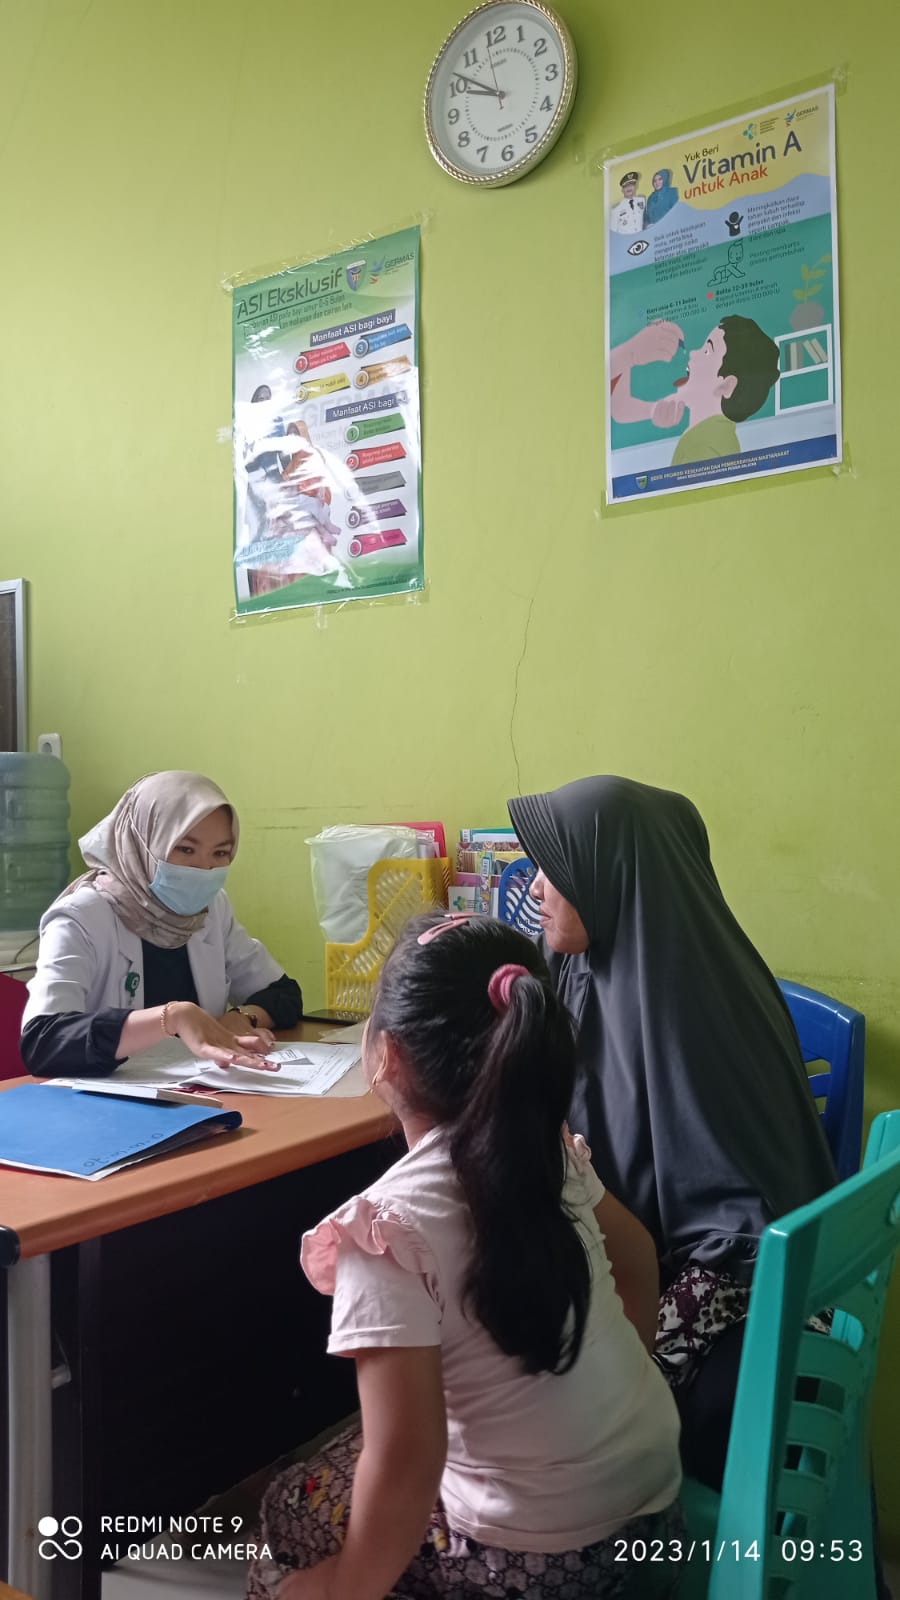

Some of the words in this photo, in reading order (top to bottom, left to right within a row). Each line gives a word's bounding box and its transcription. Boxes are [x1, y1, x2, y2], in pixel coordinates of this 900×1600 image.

[485, 26, 506, 48] 12
[516, 25, 525, 43] 1
[534, 38, 548, 57] 2
[463, 48, 478, 68] 11
[545, 64, 558, 82] 3
[450, 78, 468, 98] 10
[540, 95, 553, 112] 4
[447, 108, 460, 126] 9
[457, 131, 470, 148] 8
[525, 126, 538, 144] 5
[476, 146, 489, 163] 7
[501, 144, 514, 162] 6
[683, 142, 776, 184] Vitamin
[783, 130, 802, 157] A
[684, 150, 701, 163] Yuk
[702, 144, 719, 157] Beri
[684, 176, 725, 200] untuk
[729, 164, 768, 186] Anak
[237, 294, 263, 319] ASI
[267, 266, 343, 308] Eksklusif
[312, 330, 342, 343] Manfaat
[343, 326, 357, 336] ASI
[359, 319, 375, 332] bagi
[376, 313, 393, 325] bayi
[333, 405, 361, 417] Manfaat
[363, 402, 376, 411] ASI
[378, 399, 394, 408] bagi
